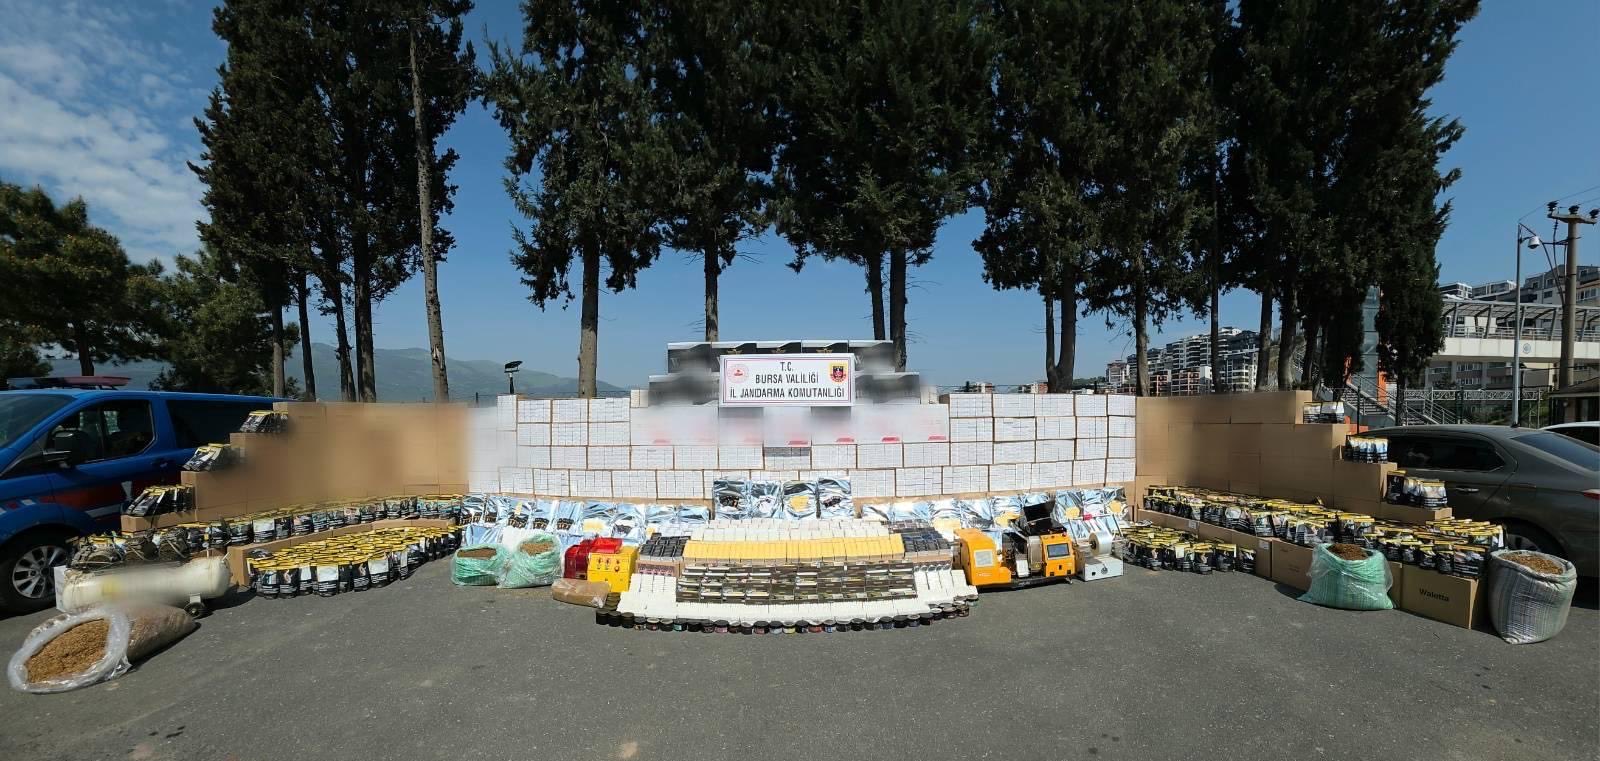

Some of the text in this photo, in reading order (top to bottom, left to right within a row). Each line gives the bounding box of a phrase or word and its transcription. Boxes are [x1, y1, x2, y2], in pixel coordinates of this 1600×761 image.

[780, 361, 794, 372] T.C.
[755, 371, 819, 384] BURSA VALİLİĞİ
[730, 386, 845, 398] İL JANDARMA KOMUTANLIĞI
